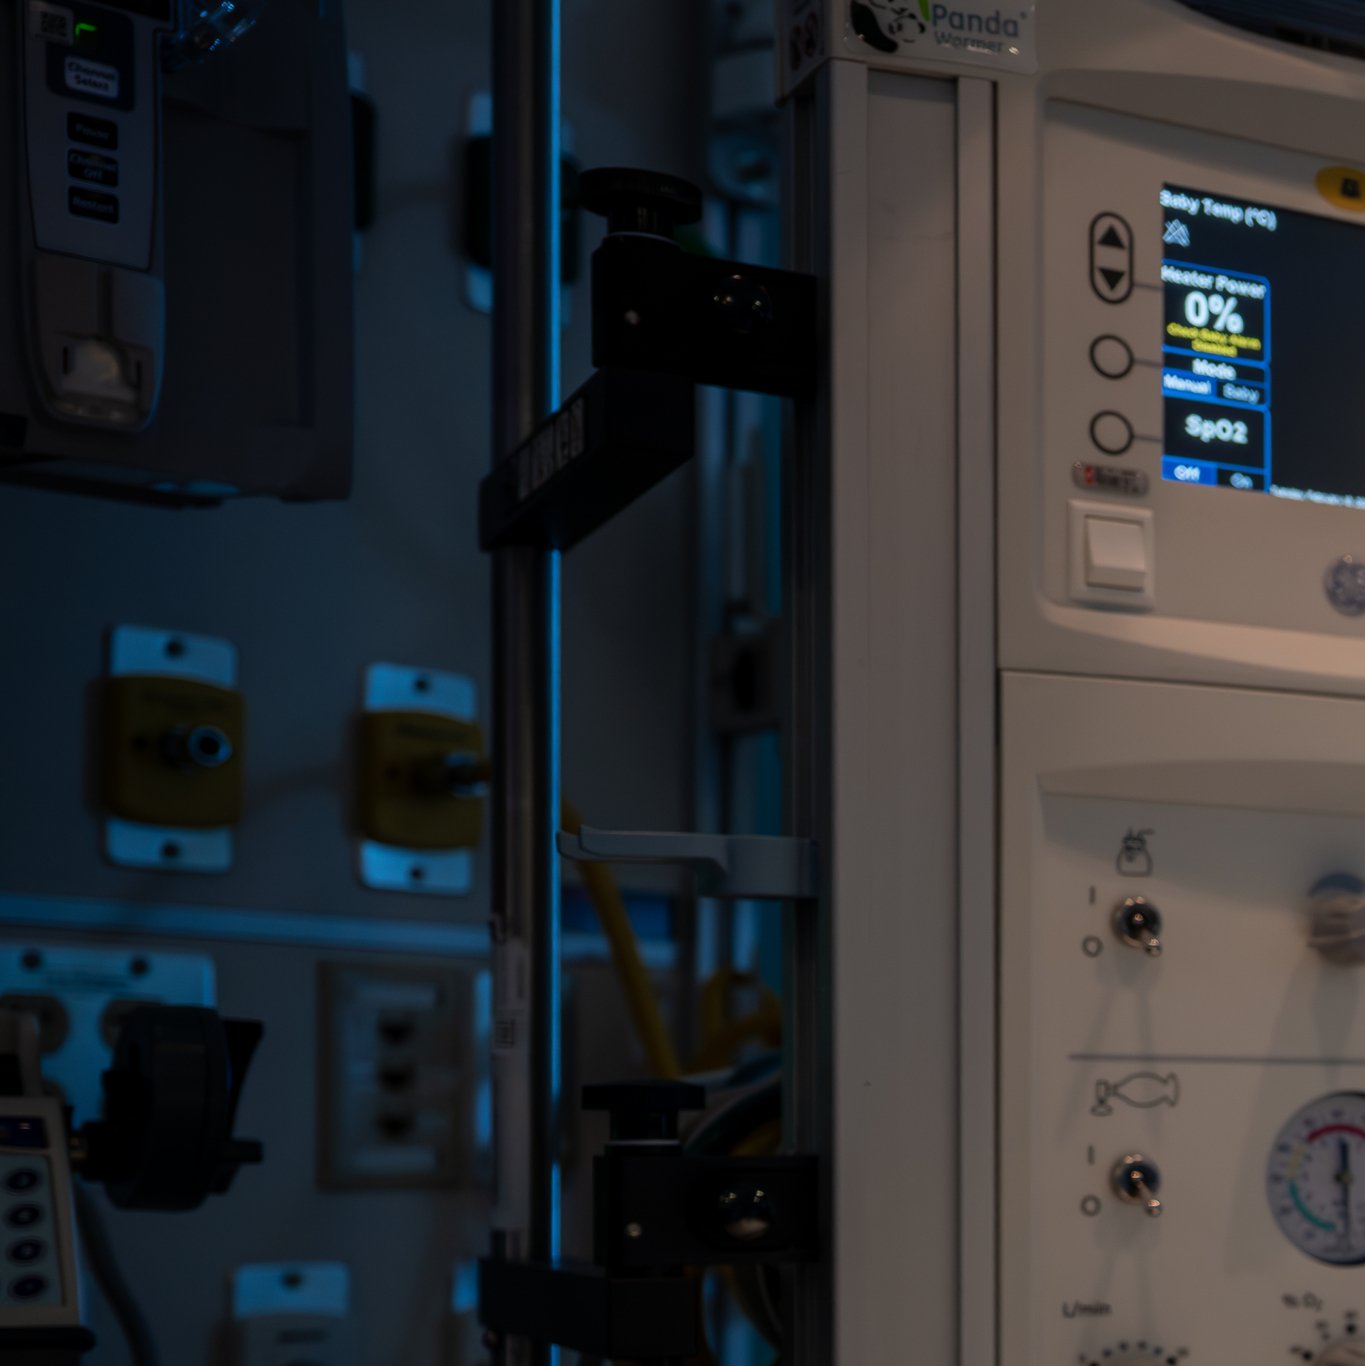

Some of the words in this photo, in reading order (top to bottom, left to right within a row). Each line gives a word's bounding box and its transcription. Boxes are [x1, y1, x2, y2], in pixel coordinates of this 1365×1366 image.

[932, 4, 1019, 38] Panda
[935, 31, 1004, 52] Warmer
[67, 61, 115, 80] Channel
[75, 74, 110, 91] Select
[1160, 189, 1200, 215] Baby
[1201, 198, 1244, 224] Temp
[1161, 265, 1214, 290] Heater
[1215, 275, 1267, 299] Power
[1184, 291, 1244, 334] 0%
[1192, 358, 1236, 381] Mode
[1163, 374, 1212, 395] Manual
[1184, 413, 1248, 444] SpO2
[1061, 1300, 1112, 1319] L/min
